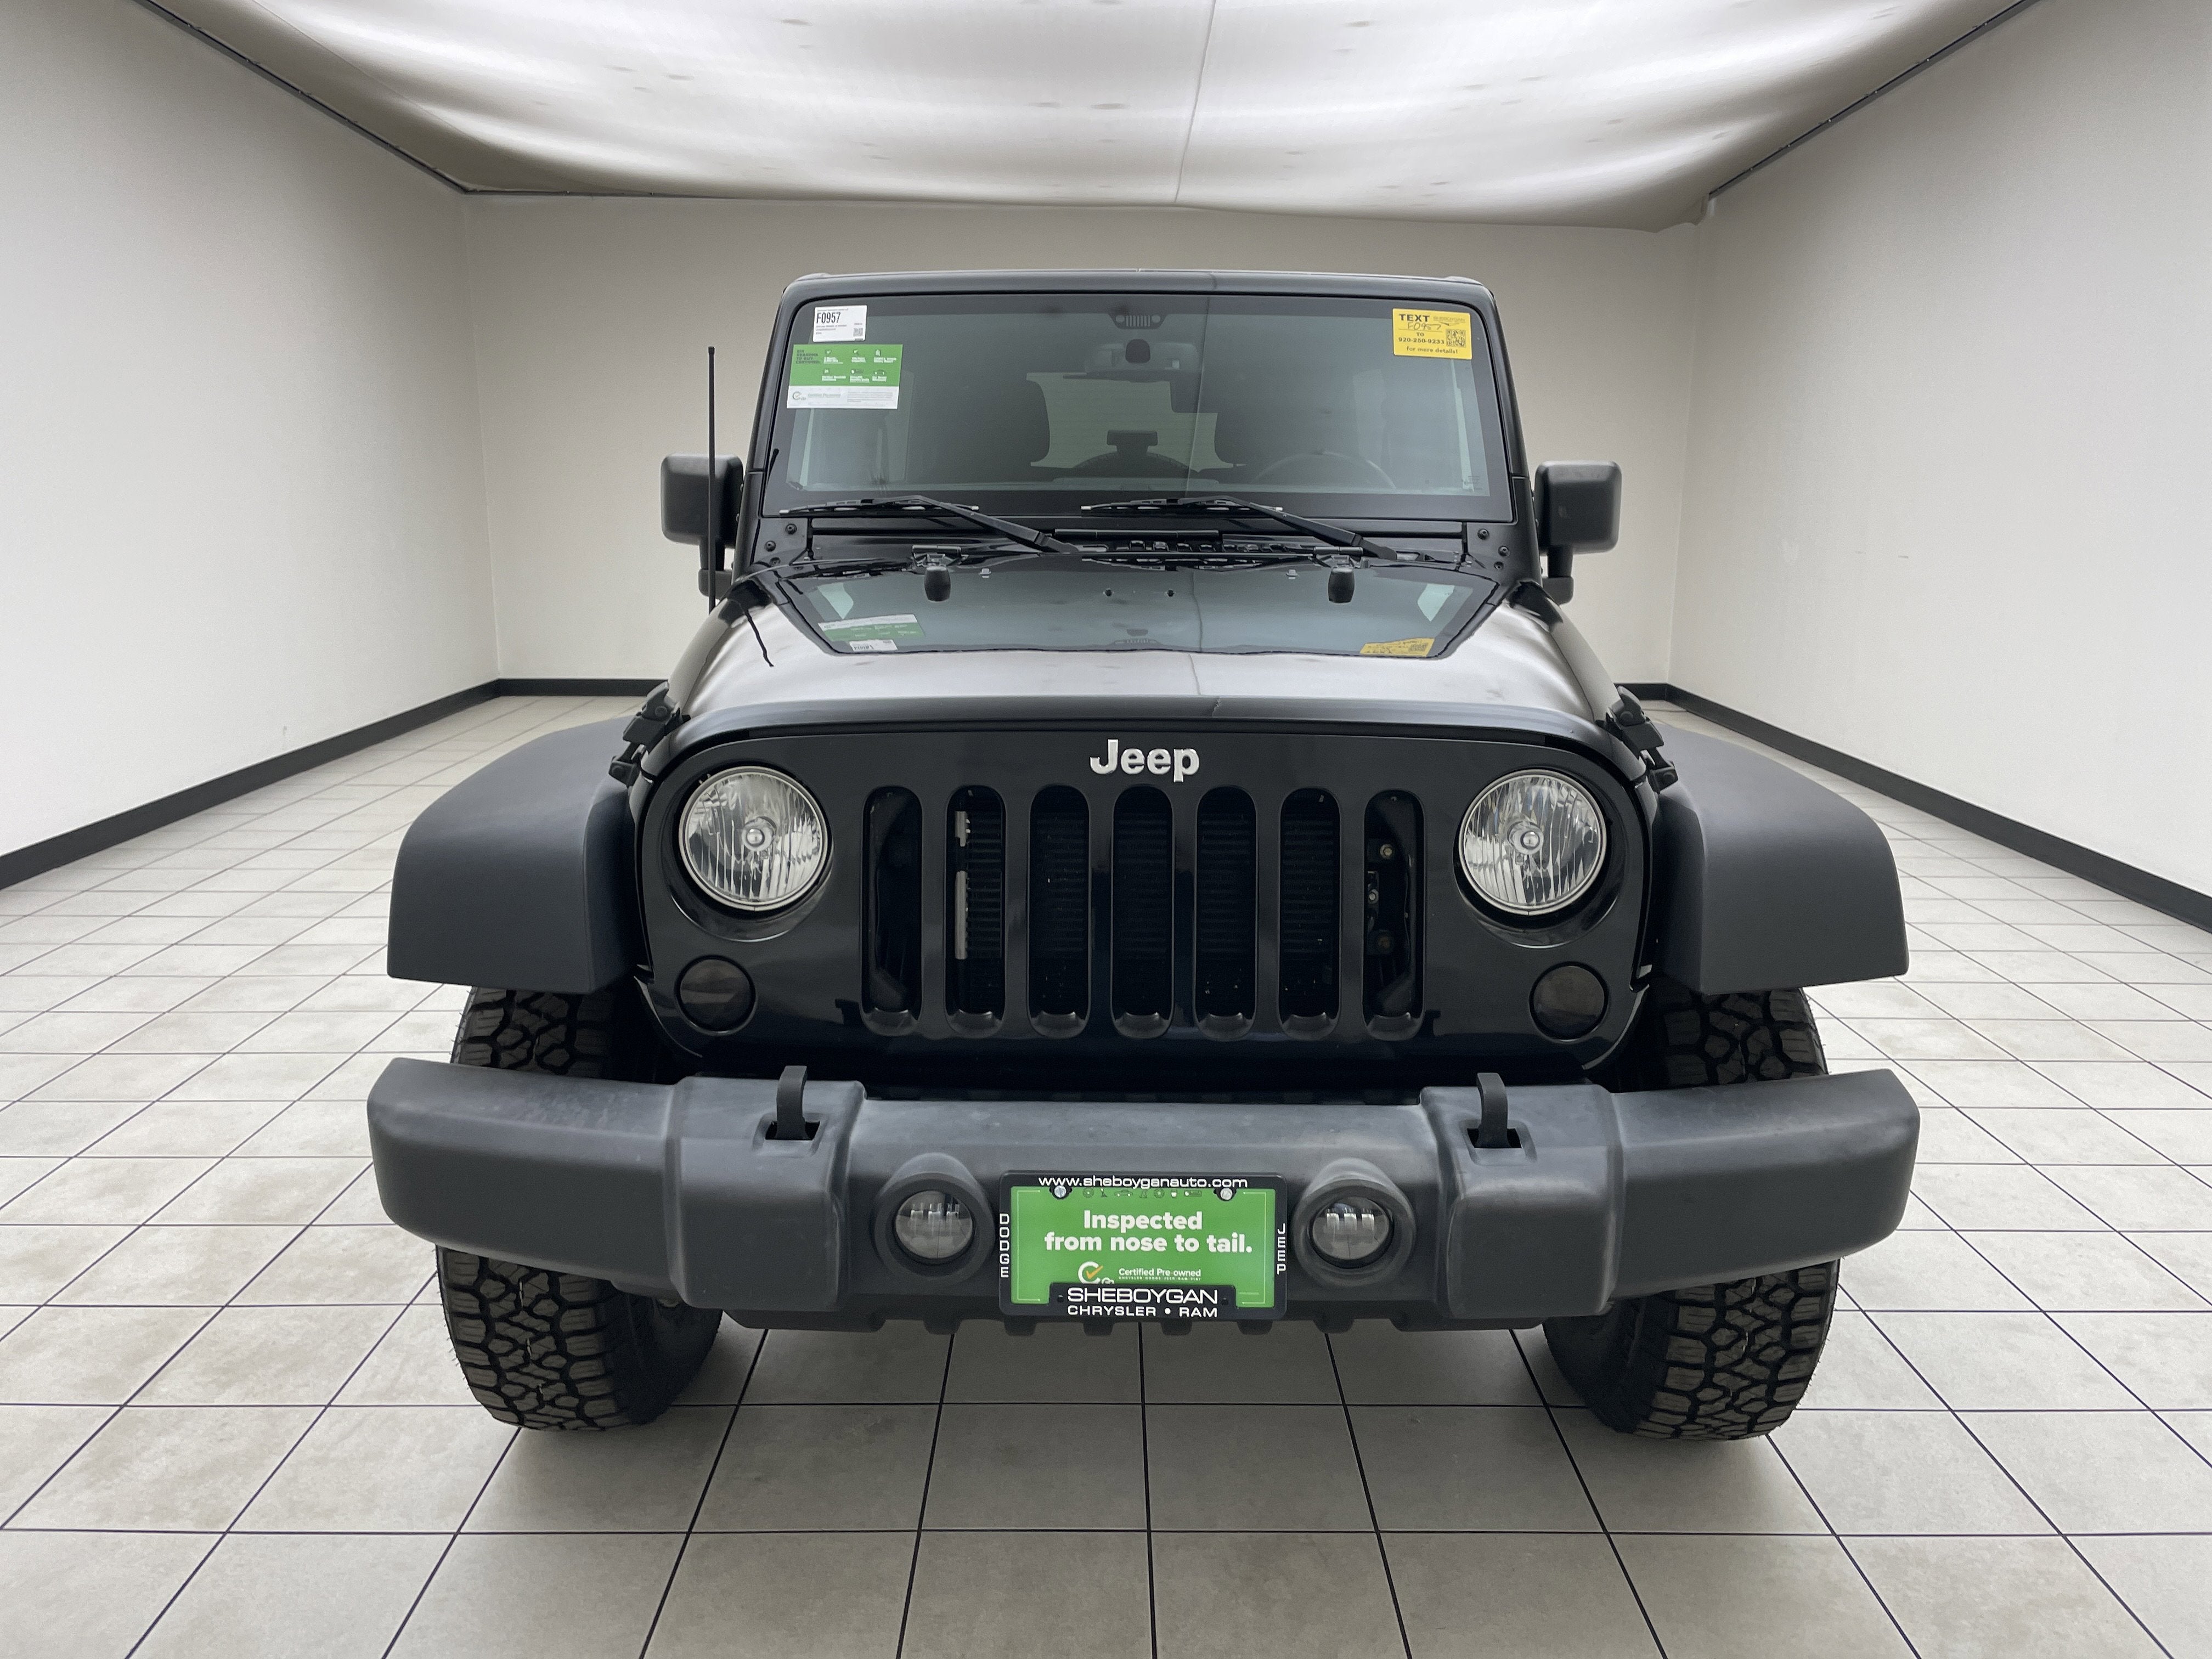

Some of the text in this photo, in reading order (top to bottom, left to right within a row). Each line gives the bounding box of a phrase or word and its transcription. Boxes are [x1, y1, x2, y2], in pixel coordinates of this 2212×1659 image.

[816, 311, 841, 324] F0957
[1398, 313, 1430, 323] TEXT
[1090, 739, 1200, 783] Jeep
[1038, 1175, 1248, 1189] www.sheboyganauto.com
[1084, 1210, 1203, 1234] Inspected
[999, 1213, 1010, 1278] DODGE
[1044, 1231, 1252, 1253] from nose to tail.
[1277, 1223, 1286, 1275] JEEP
[1118, 1268, 1154, 1276] Certified
[1067, 1287, 1218, 1305] SHEBOYGAN
[1067, 1305, 1218, 1318] CHRYSLER RAM
